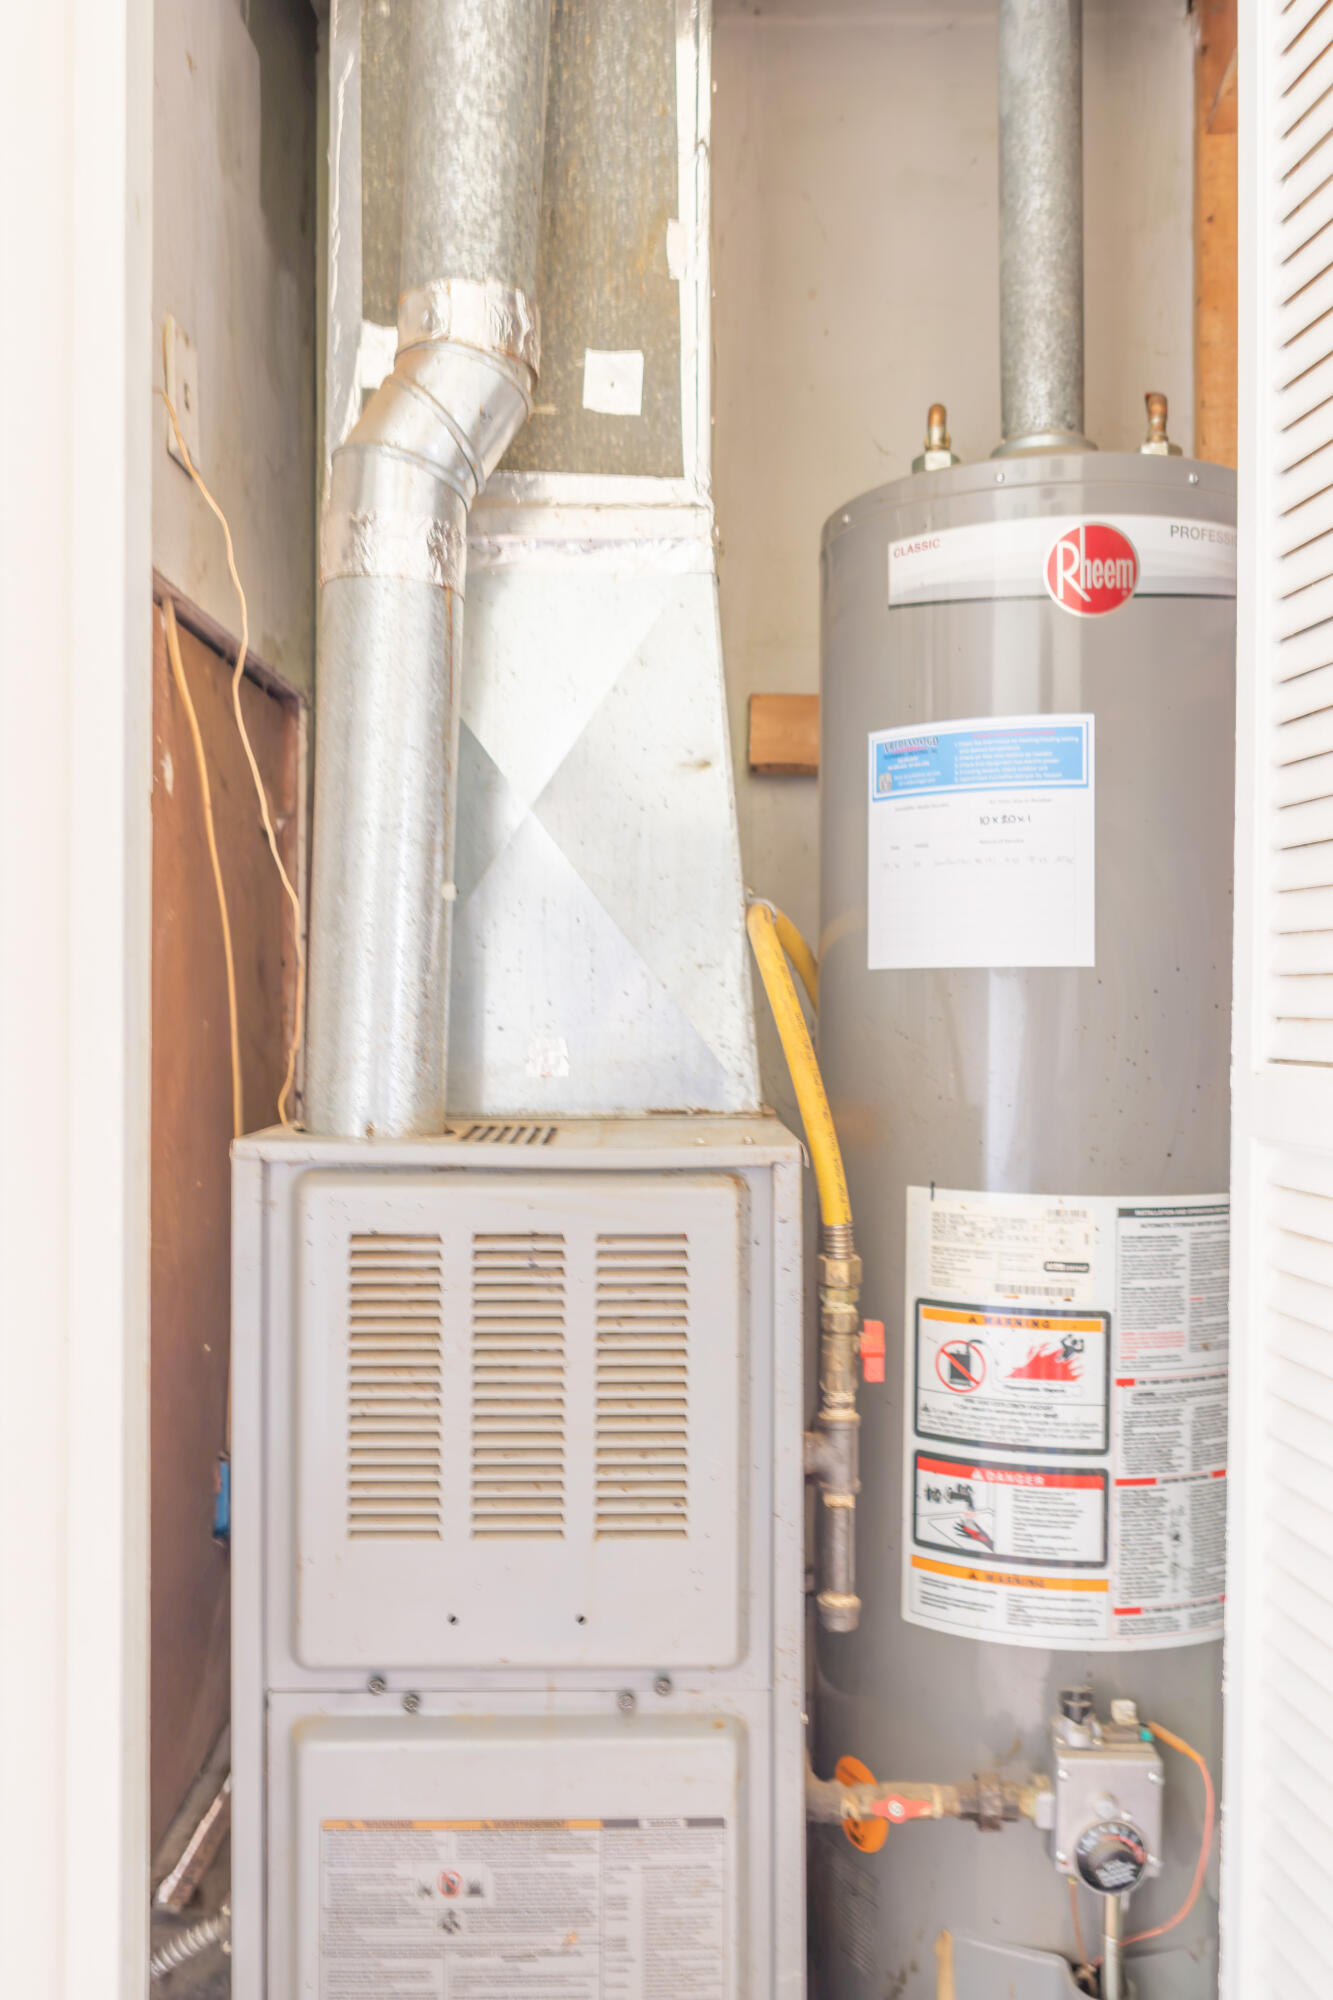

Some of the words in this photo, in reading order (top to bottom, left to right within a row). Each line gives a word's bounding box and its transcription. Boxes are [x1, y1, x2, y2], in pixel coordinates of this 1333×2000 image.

[1170, 524, 1237, 547] PROFESSI
[893, 538, 941, 559] CLASSIC
[1056, 525, 1134, 602] Rheem
[984, 1316, 1051, 1329] WARNING
[985, 1471, 1045, 1486] DANGER
